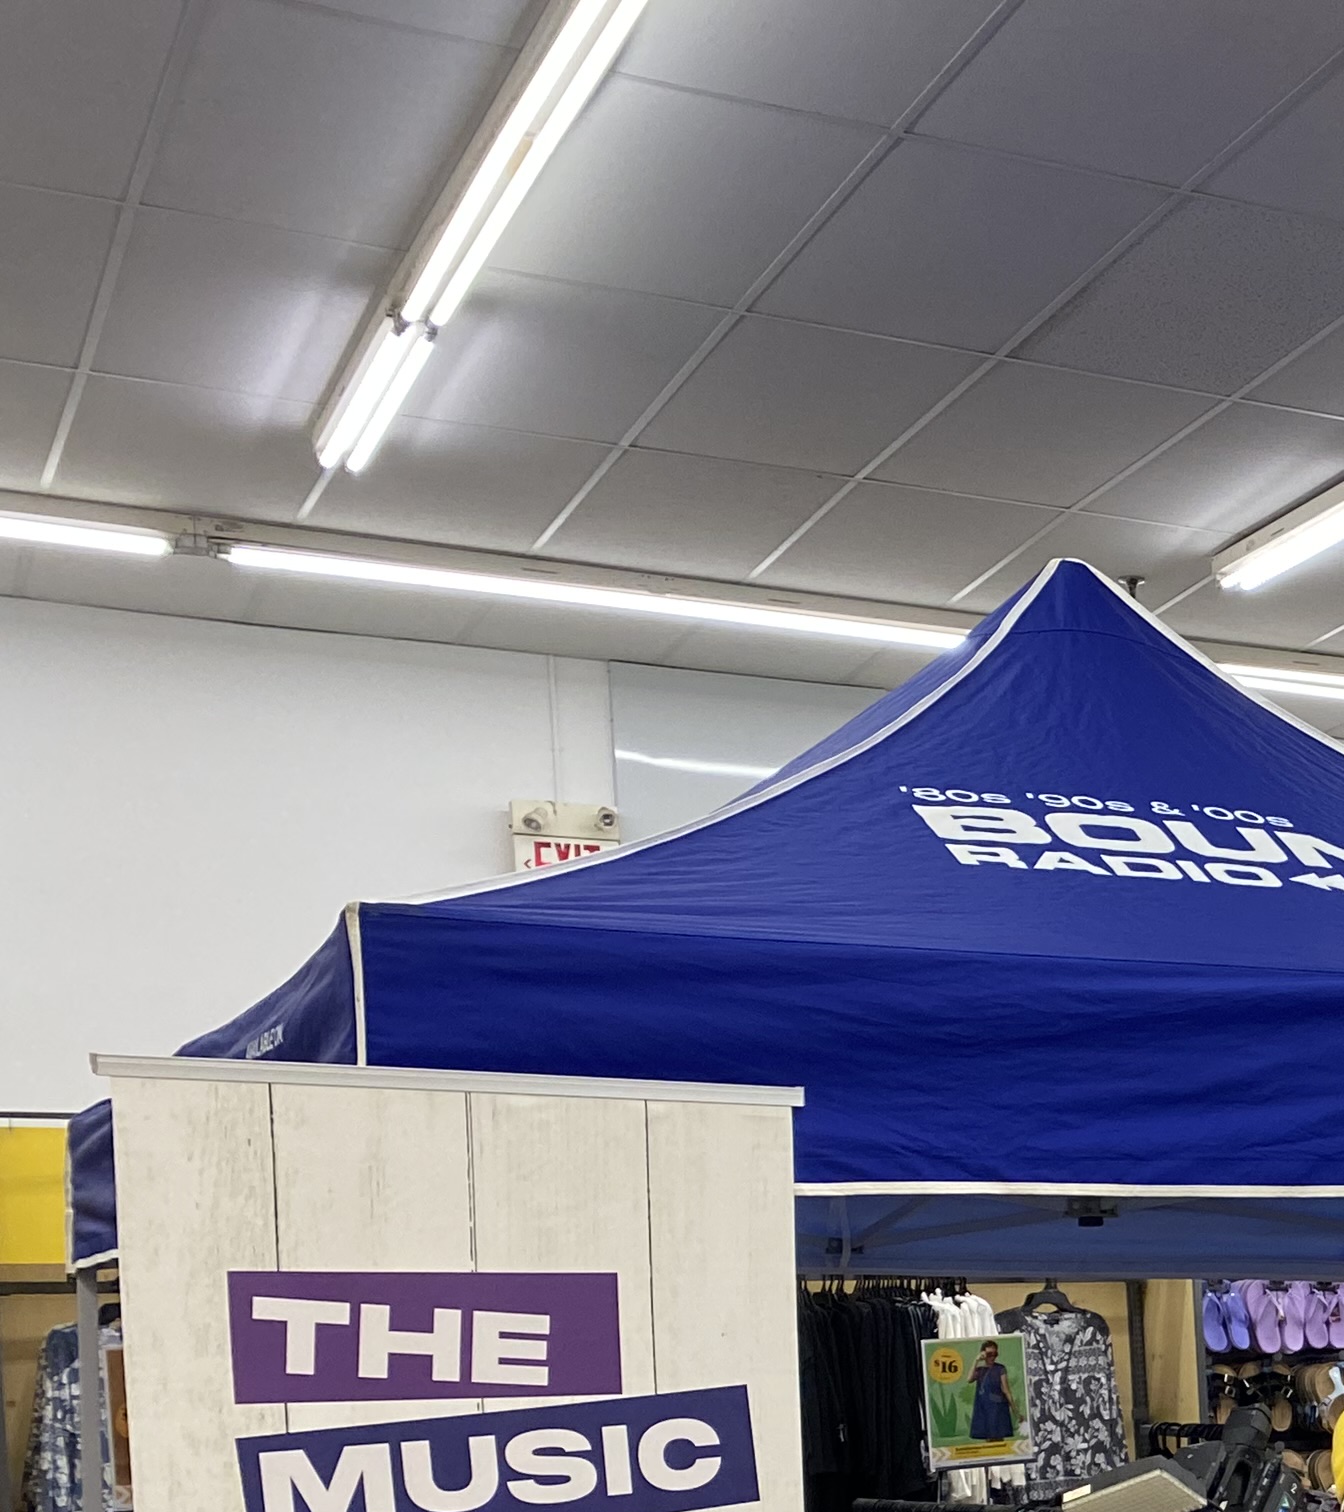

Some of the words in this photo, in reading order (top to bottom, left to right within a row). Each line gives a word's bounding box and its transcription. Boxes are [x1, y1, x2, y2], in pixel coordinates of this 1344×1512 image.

[898, 785, 1011, 805] '80s
[1026, 791, 1133, 814] '90s
[1151, 800, 1185, 816] &
[945, 843, 1284, 888] RADIO
[252, 1295, 551, 1387] THE
[934, 1359, 958, 1374] $16
[1290, 1483, 1298, 1494] 2
